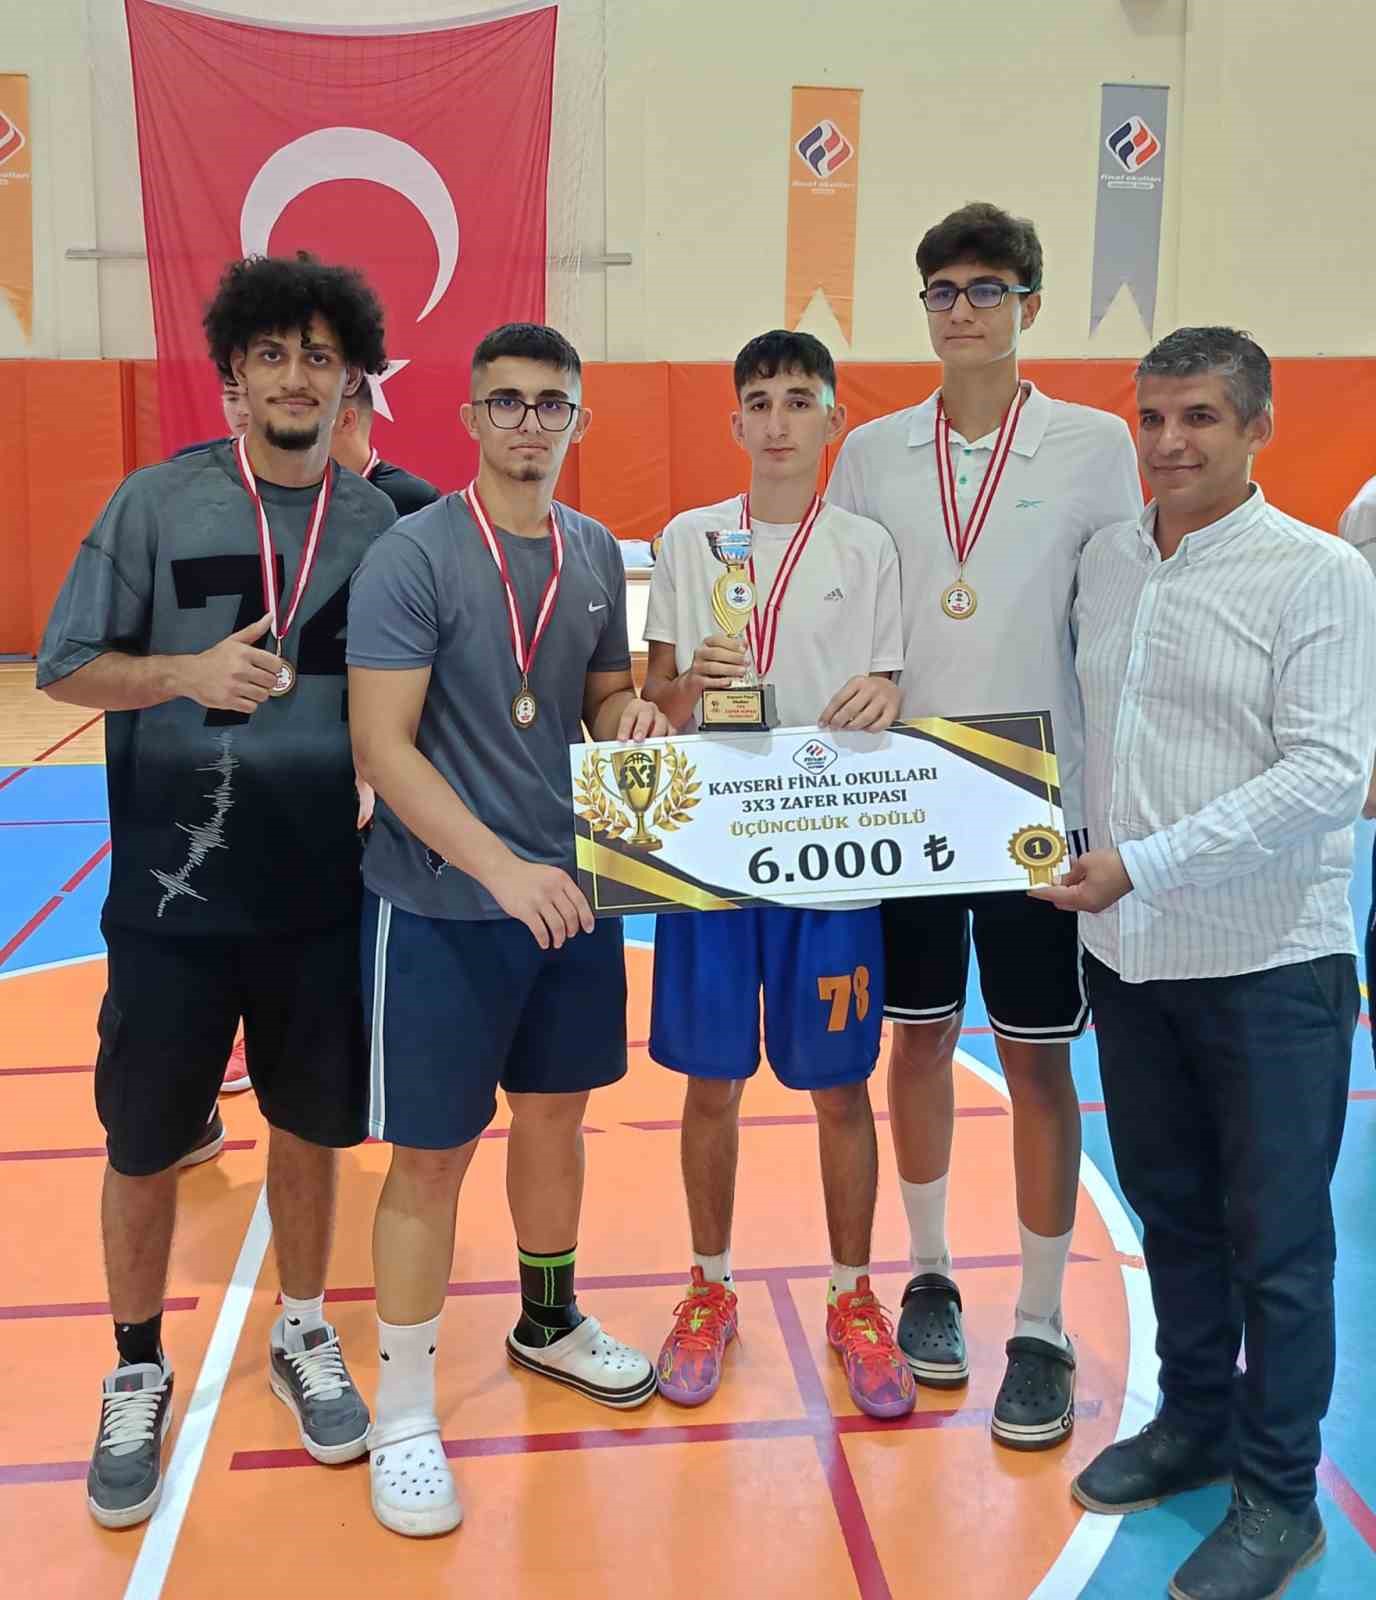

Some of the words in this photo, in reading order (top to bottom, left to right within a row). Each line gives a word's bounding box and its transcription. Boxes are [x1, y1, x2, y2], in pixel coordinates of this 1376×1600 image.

[708, 775, 783, 796] KAYSERİ
[788, 773, 841, 791] FİNAL
[845, 767, 938, 786] OKULLARI
[742, 798, 775, 813] 3X3
[780, 795, 837, 811] ZAFER
[843, 789, 908, 806] KUPASI
[730, 815, 849, 838] ÜÇÜNCÜLÜK
[858, 808, 927, 828] ÖDÜLÜ
[747, 838, 902, 885] 6.000
[923, 833, 955, 872] ₺
[1031, 840, 1045, 856] 1
[817, 966, 870, 1032] 78
